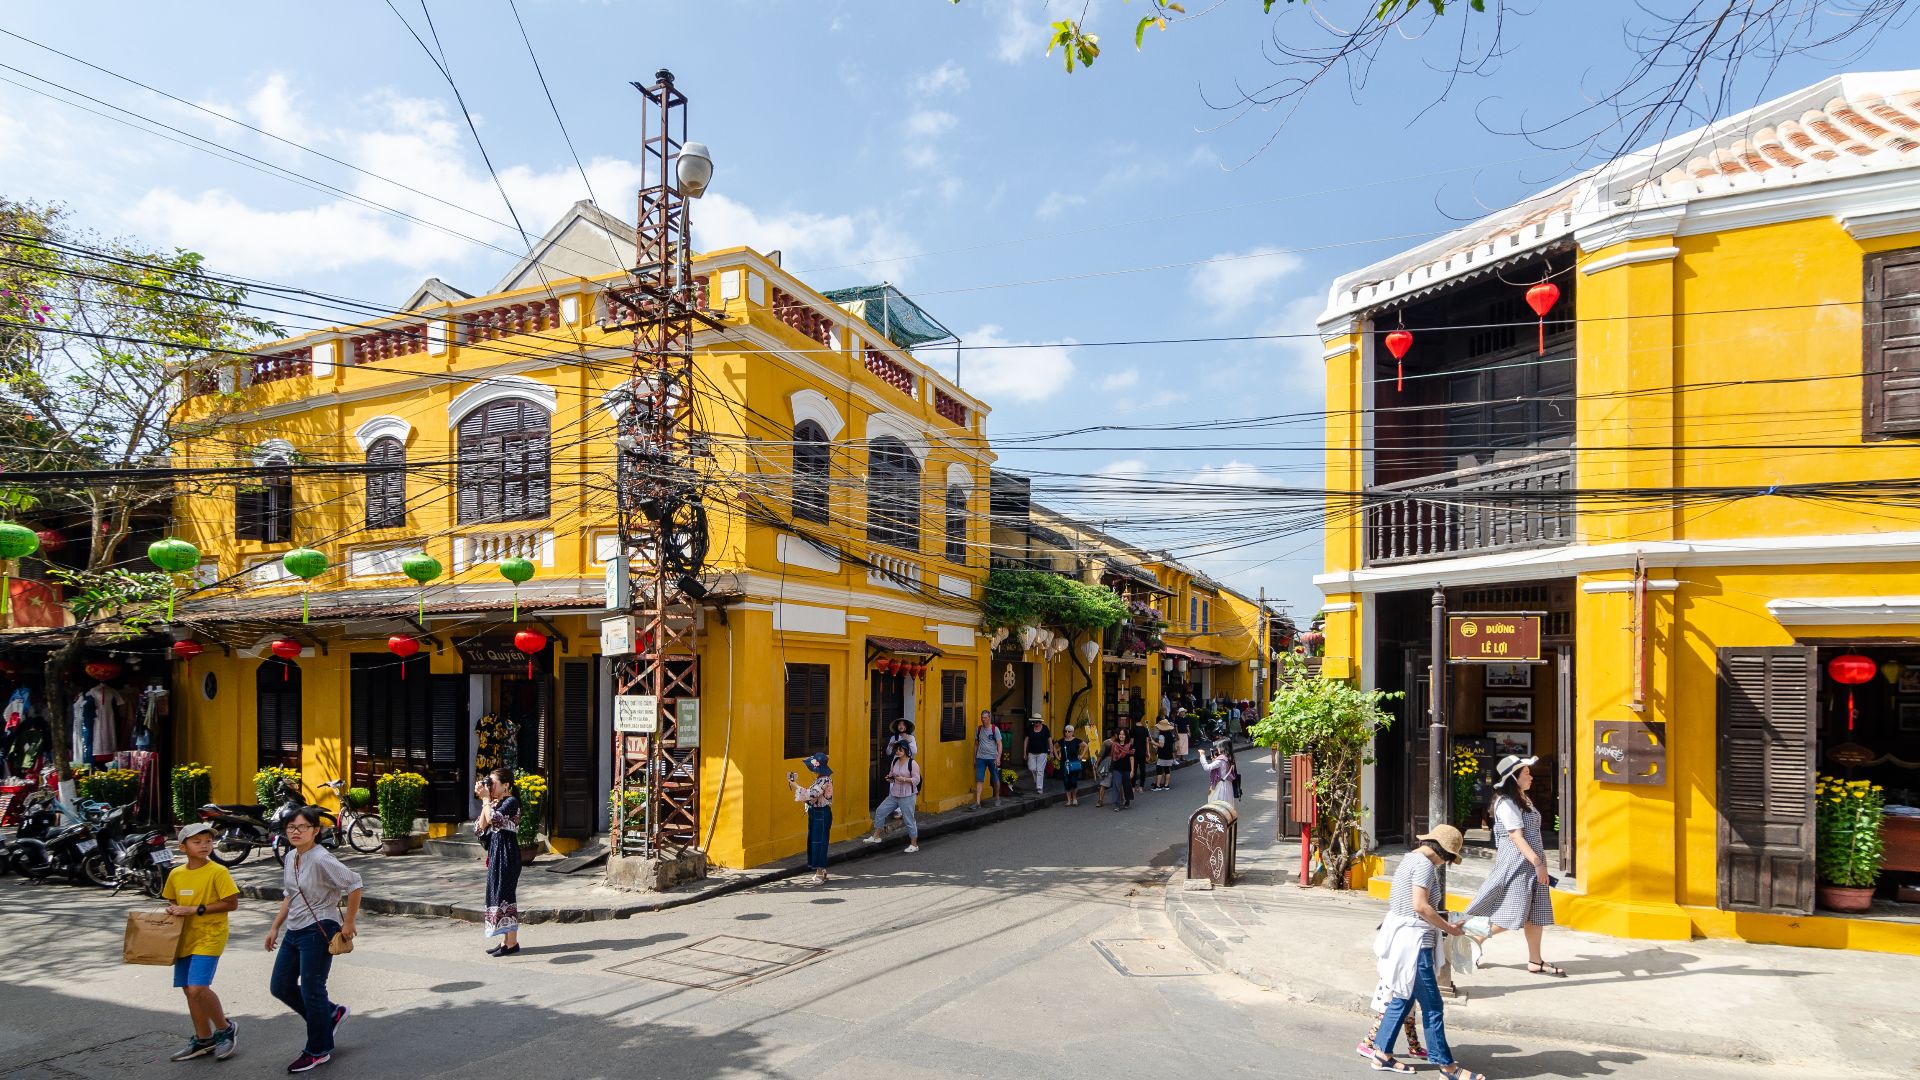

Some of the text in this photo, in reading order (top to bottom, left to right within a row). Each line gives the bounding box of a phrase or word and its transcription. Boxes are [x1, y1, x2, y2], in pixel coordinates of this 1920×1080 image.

[1486, 622, 1515, 634] ĐƯỜNG
[1481, 640, 1508, 655] LÊ LỢI
